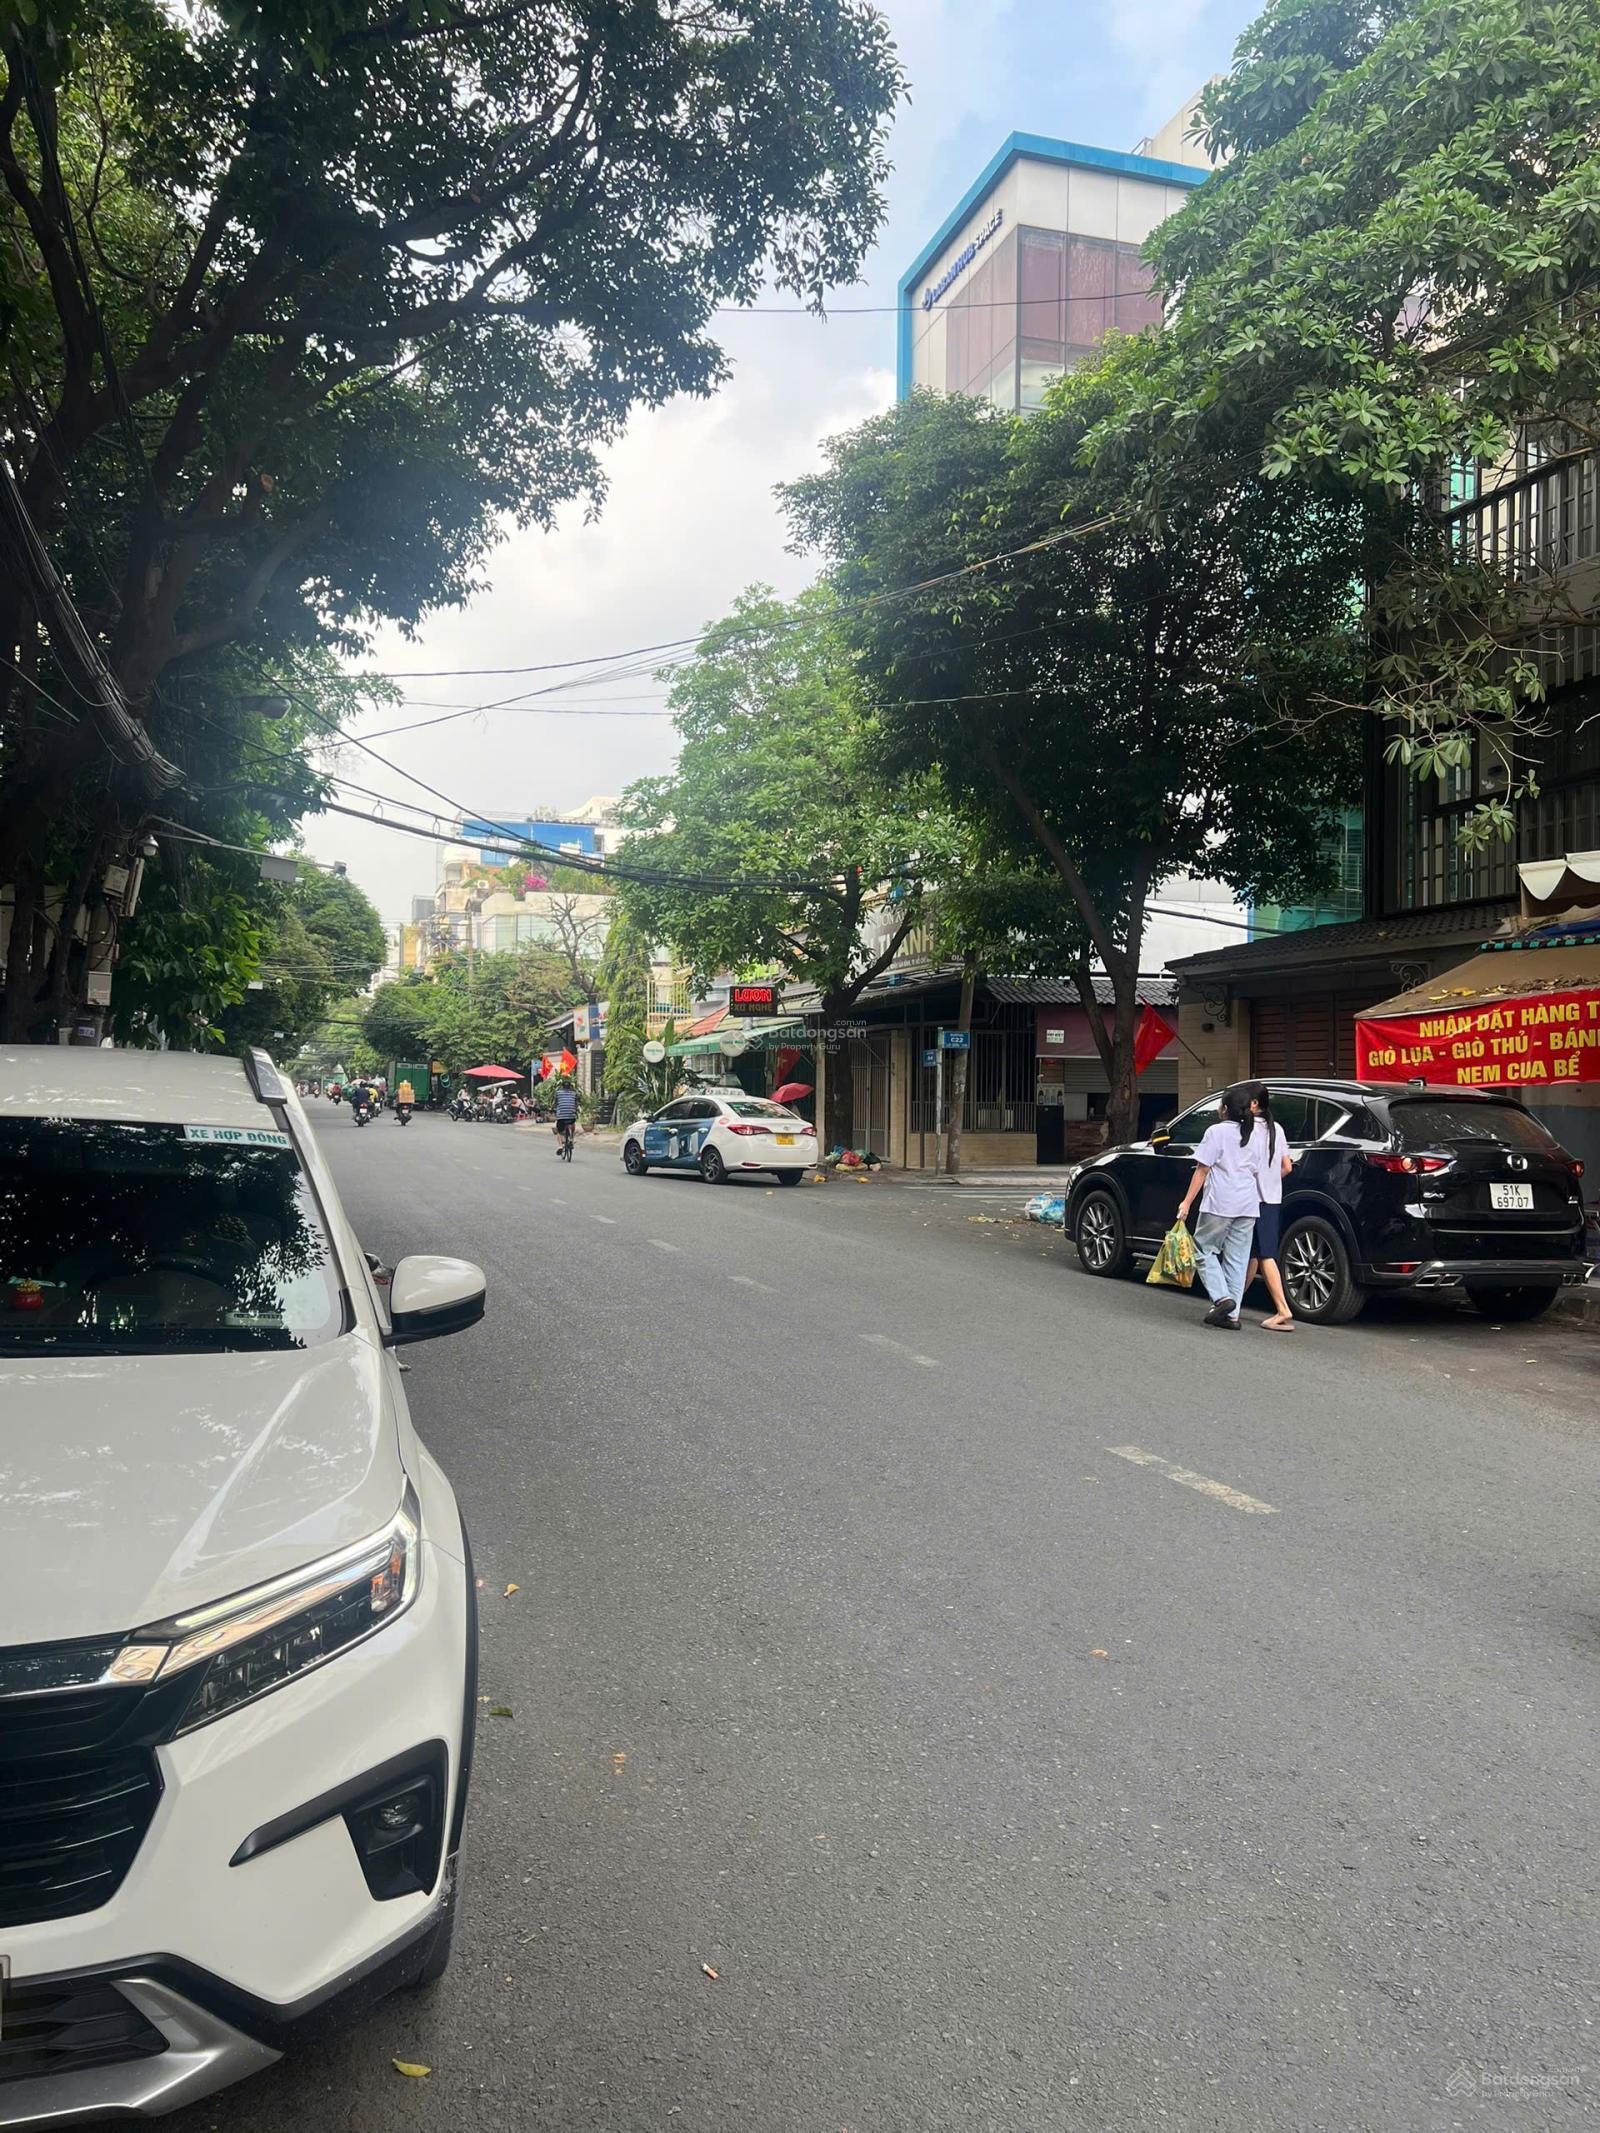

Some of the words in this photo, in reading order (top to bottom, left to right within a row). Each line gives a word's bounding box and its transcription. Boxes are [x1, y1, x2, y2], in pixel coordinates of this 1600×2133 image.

[1476, 1008, 1515, 1033] ĐẶT
[1521, 1002, 1580, 1026] HÀNG
[1368, 1045, 1397, 1067] GIÒ
[1401, 1046, 1435, 1067] LỤA
[1451, 1036, 1485, 1060] GIÒ
[1490, 1029, 1529, 1056] THỦ
[1549, 1026, 1600, 1050] BÁN
[1457, 1064, 1501, 1084] NEM
[1506, 1060, 1548, 1081] CUA
[1553, 1050, 1581, 1078] BỂ
[189, 1128, 209, 1139] XE
[1503, 1184, 1520, 1197] 51K
[1496, 1196, 1530, 1209] 697.07
